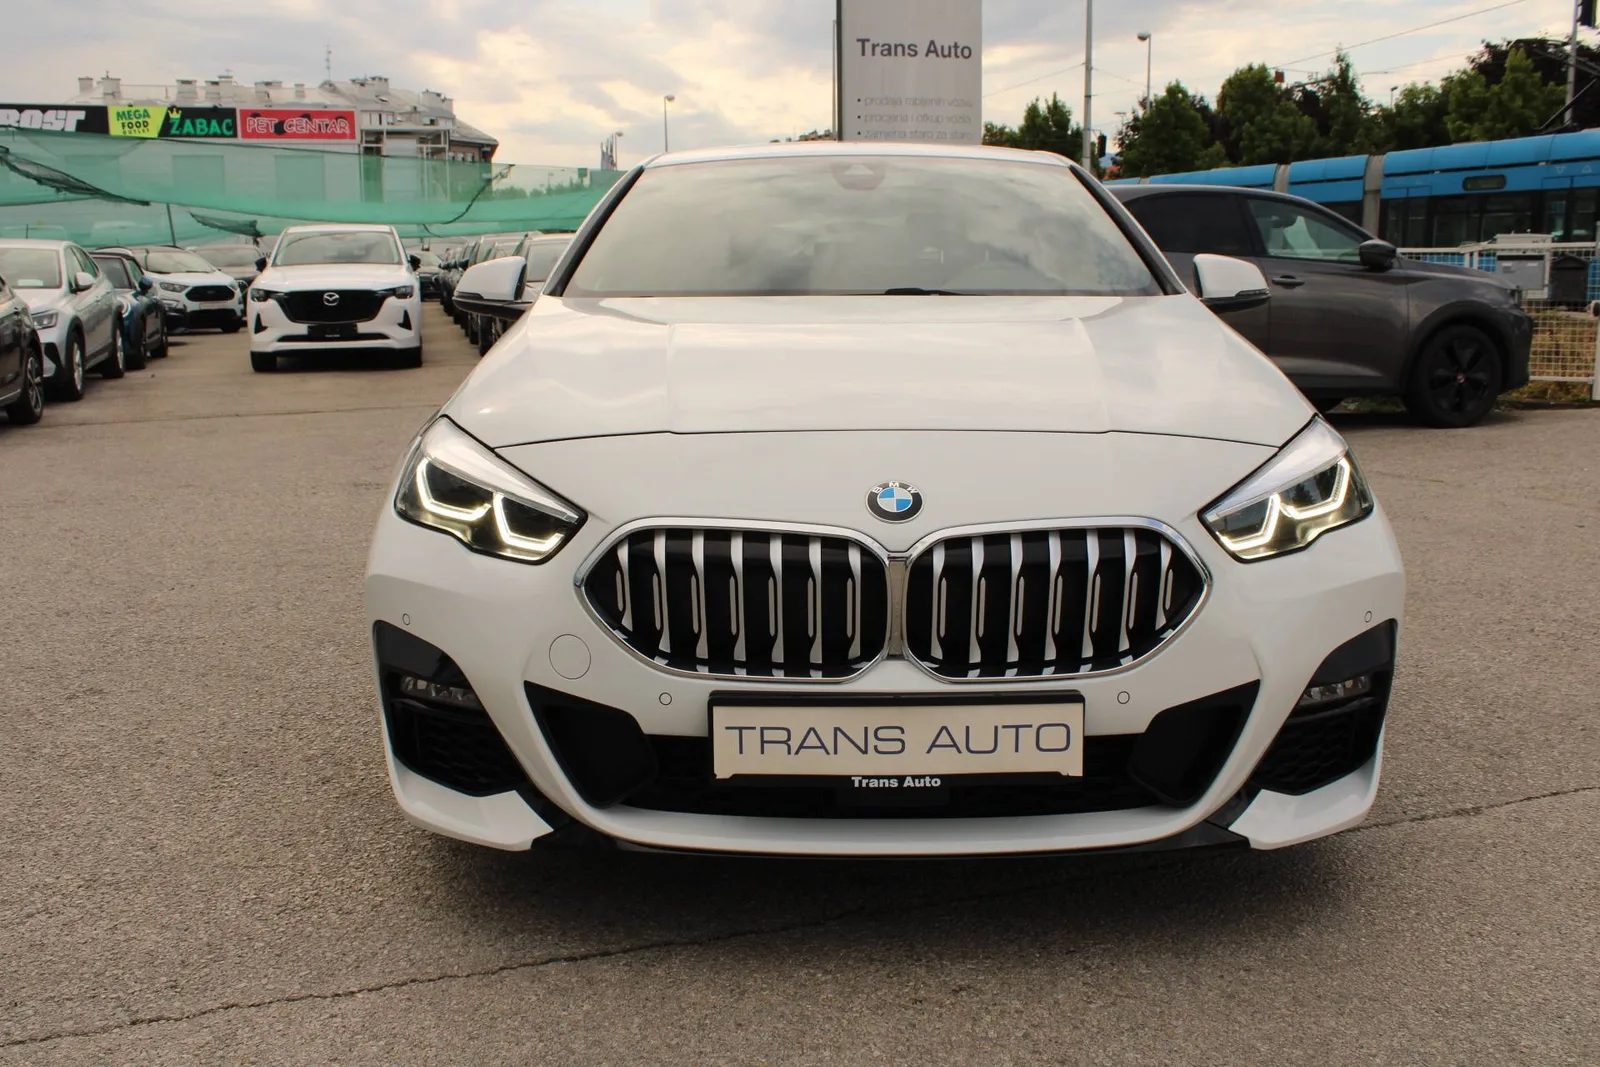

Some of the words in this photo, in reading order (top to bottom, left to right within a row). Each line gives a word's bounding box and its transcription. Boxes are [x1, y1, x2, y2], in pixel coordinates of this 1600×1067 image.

[856, 38, 918, 57] Trans
[925, 40, 972, 59] Auto
[116, 109, 150, 121] MEGA
[121, 120, 149, 130] FOOD
[246, 117, 276, 133] PET
[284, 116, 350, 134] CENTAR
[872, 481, 920, 493] BMW
[725, 725, 906, 755] TRANS
[926, 723, 1071, 755] AUTO
[851, 776, 898, 788] Trans
[903, 776, 941, 788] Auto
